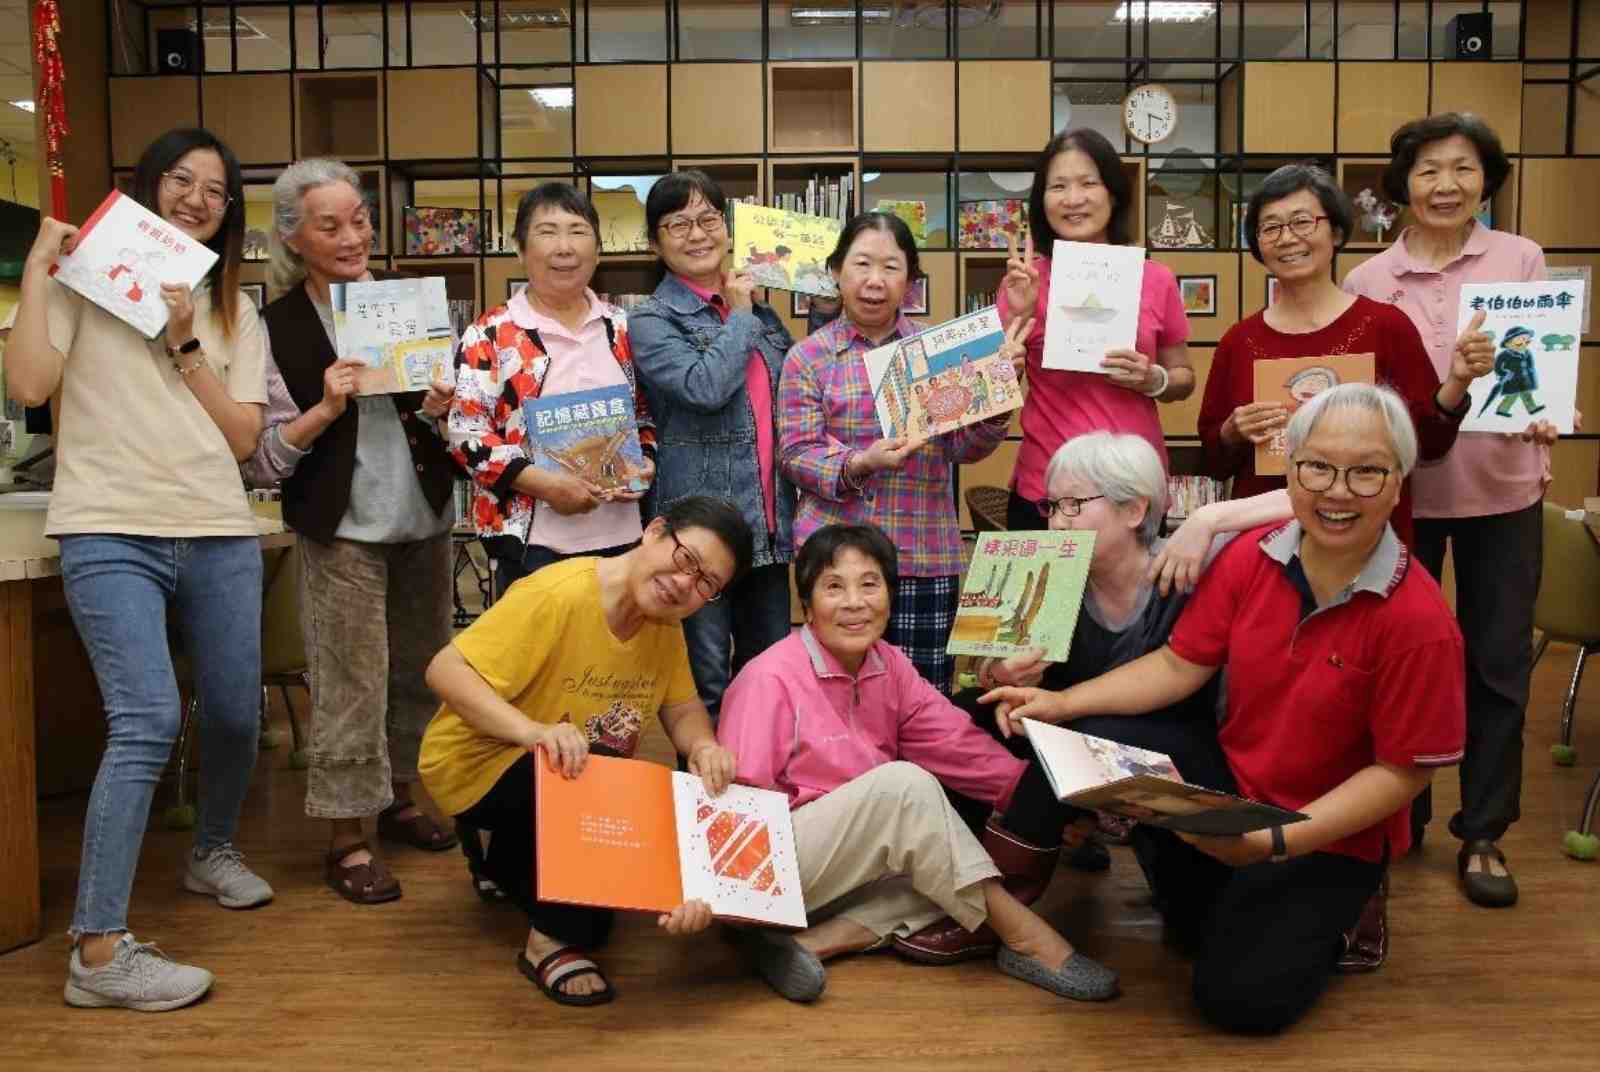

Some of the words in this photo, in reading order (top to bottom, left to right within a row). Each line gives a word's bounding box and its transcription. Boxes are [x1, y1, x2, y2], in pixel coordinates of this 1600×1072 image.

[1470, 291, 1575, 311] 老伯伯的雨傘
